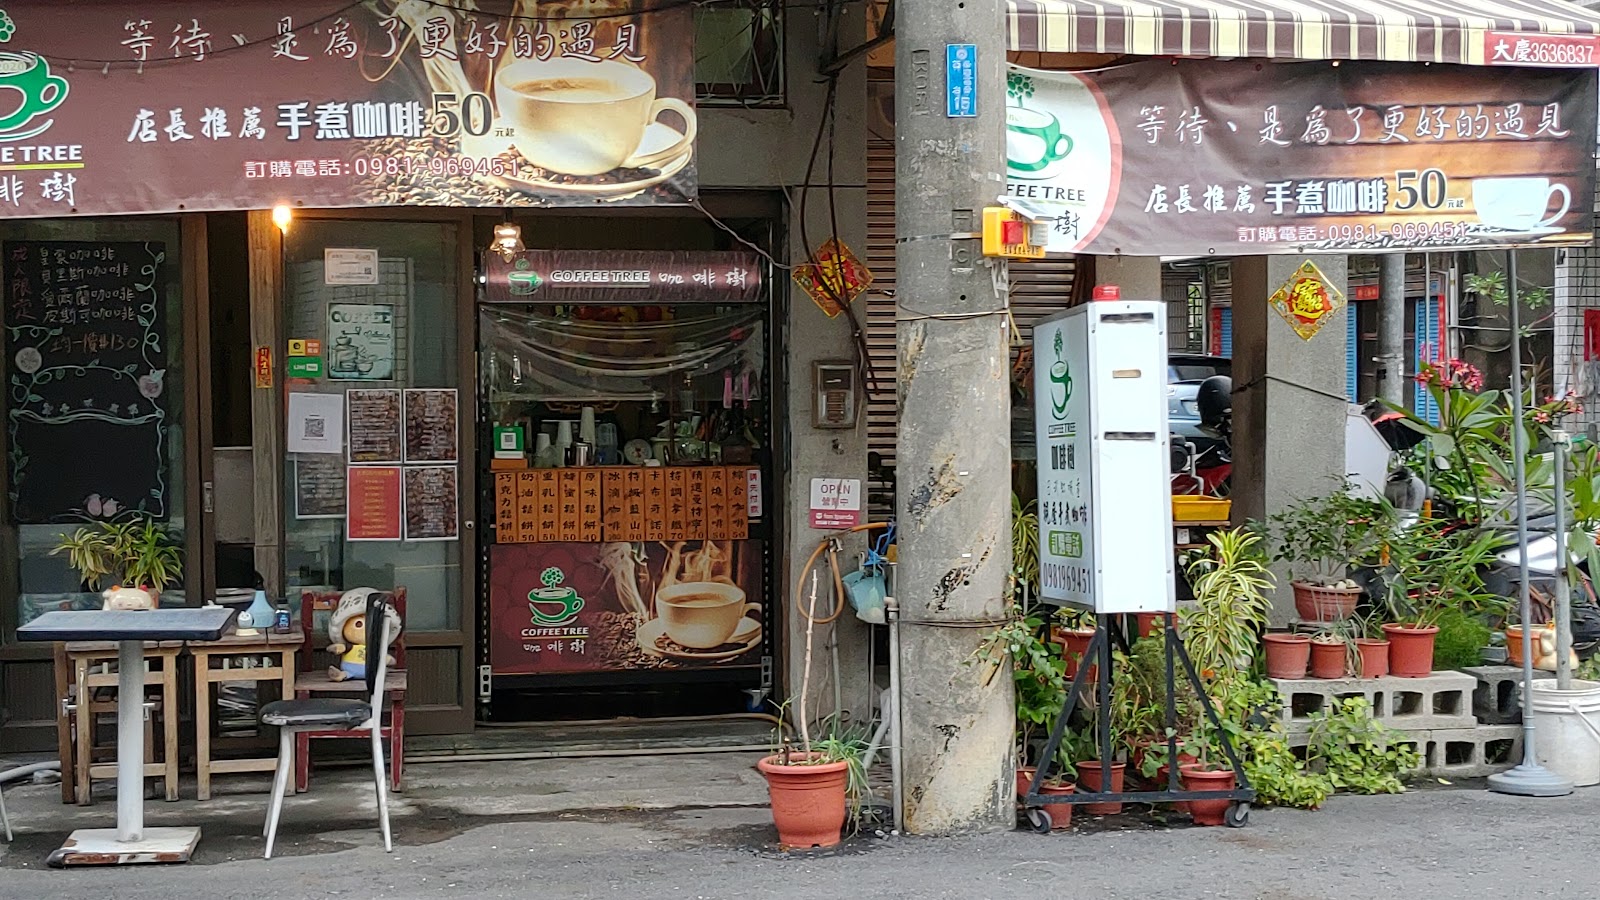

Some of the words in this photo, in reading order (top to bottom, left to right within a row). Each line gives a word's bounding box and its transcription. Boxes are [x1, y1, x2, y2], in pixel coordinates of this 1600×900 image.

[18, 145, 82, 161] TREE
[1041, 186, 1086, 202] TREE
[551, 270, 609, 283] COFFEE
[612, 270, 650, 283] TREE
[1043, 562, 1091, 594] 0981969451
[521, 628, 560, 636] COFFEE
[562, 627, 589, 635] TREE
